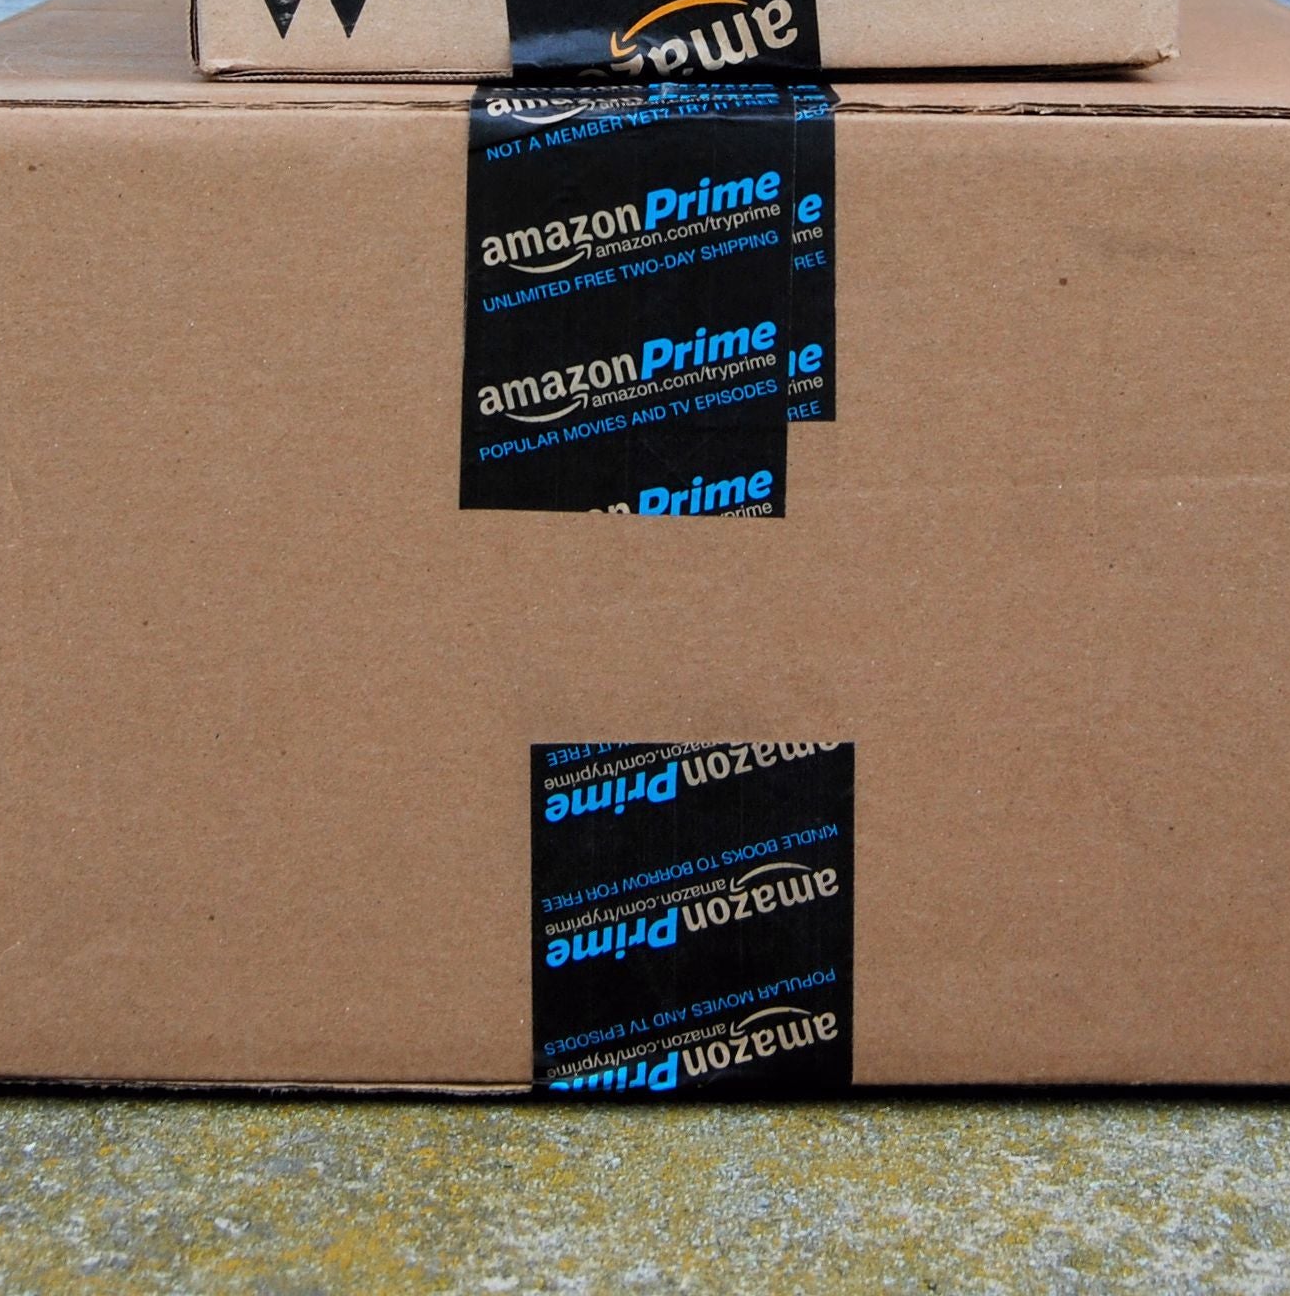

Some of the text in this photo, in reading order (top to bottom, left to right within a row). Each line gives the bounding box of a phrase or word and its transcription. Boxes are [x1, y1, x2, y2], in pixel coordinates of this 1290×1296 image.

[486, 140, 522, 161] NOT
[529, 136, 541, 151] A
[545, 116, 622, 147] MEMBER
[627, 108, 670, 127] YET?
[595, 202, 781, 258] amazon.com/tryprime
[483, 280, 570, 313] UNLIMITED
[574, 268, 617, 291] FREE
[620, 249, 696, 280] TWO-DAY
[701, 230, 779, 261] SHIPPING
[592, 352, 776, 408] amazon.com/tryprime
[479, 431, 559, 461] POPULAR
[563, 415, 627, 441] MOVIES
[631, 406, 667, 426] AND
[669, 399, 691, 416] TV
[695, 379, 777, 410] EPISODES
[546, 743, 591, 767] FREE
[542, 824, 838, 912] KINDLE BOOKS TO BORROW FOR FREE
[545, 878, 725, 935] amazon.com/tryprime
[544, 968, 836, 1055] POPULAR MOVIES AND TV EPISODES
[547, 1023, 726, 1078] amazon.com/tryprime
